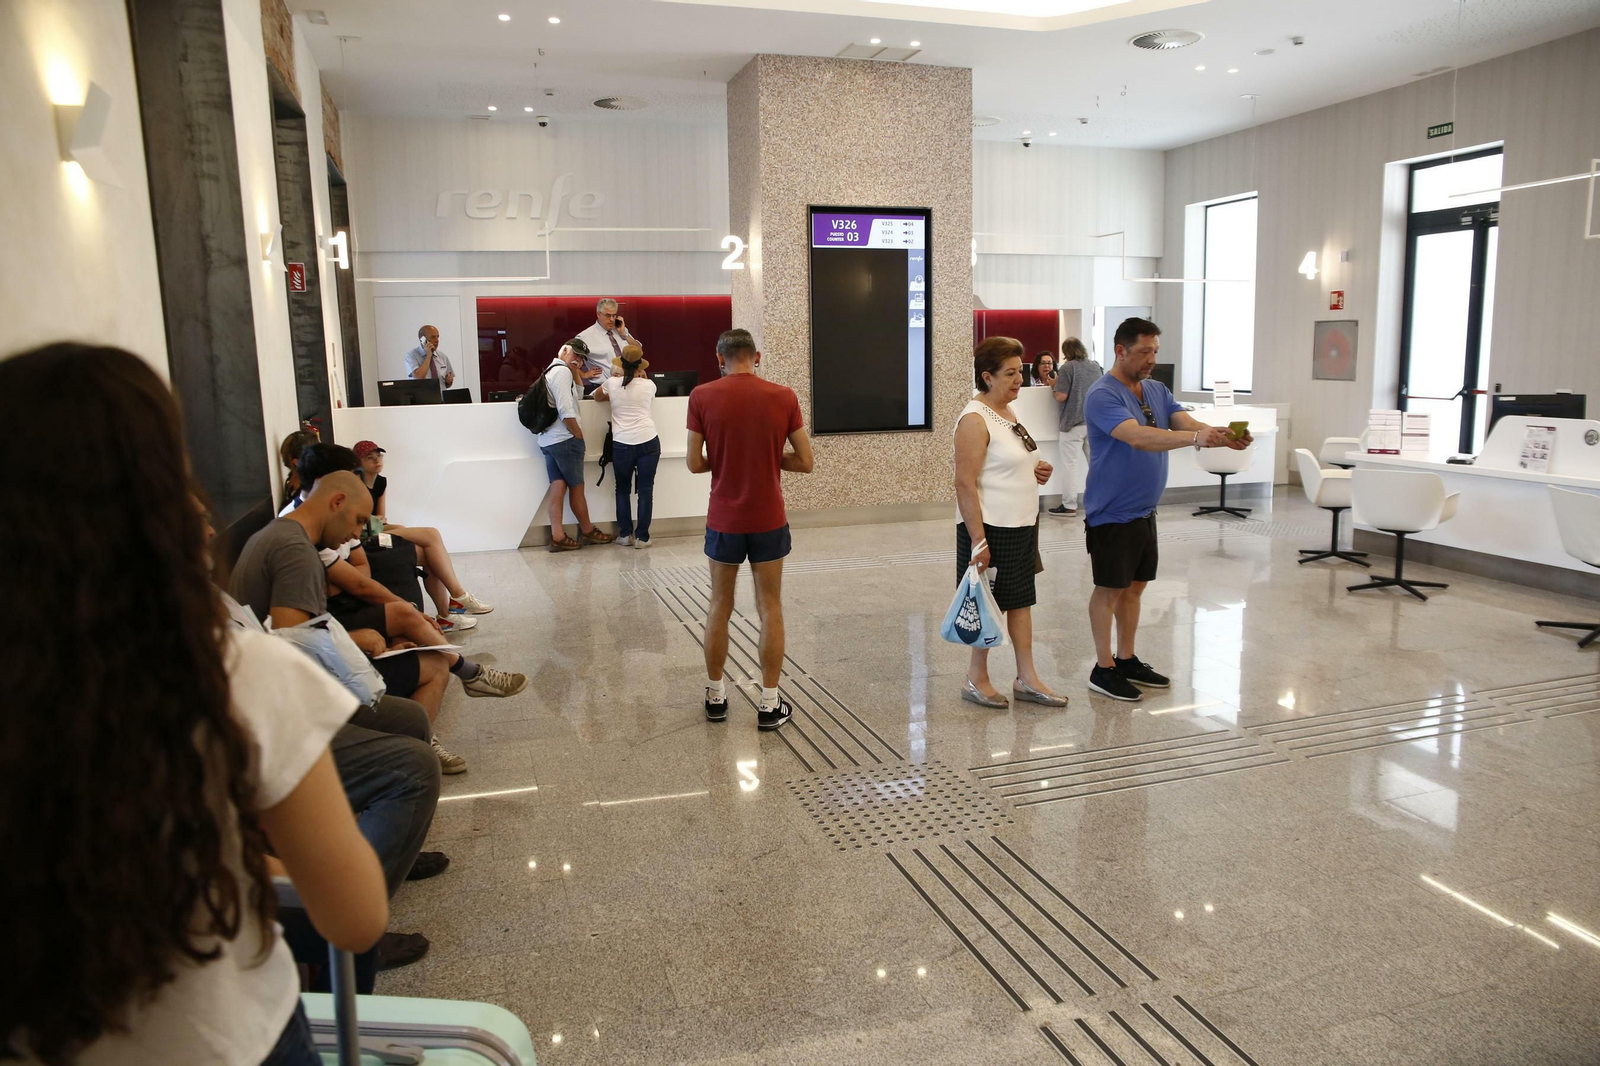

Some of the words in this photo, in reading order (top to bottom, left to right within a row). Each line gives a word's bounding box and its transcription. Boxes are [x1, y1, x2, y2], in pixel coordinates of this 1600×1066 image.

[1430, 124, 1452, 136] SALIDA
[434, 171, 606, 237] renfe
[831, 219, 858, 230] V326
[846, 232, 860, 242] 03
[328, 231, 350, 269] 1
[721, 235, 745, 270] 2
[1298, 251, 1319, 280] 4
